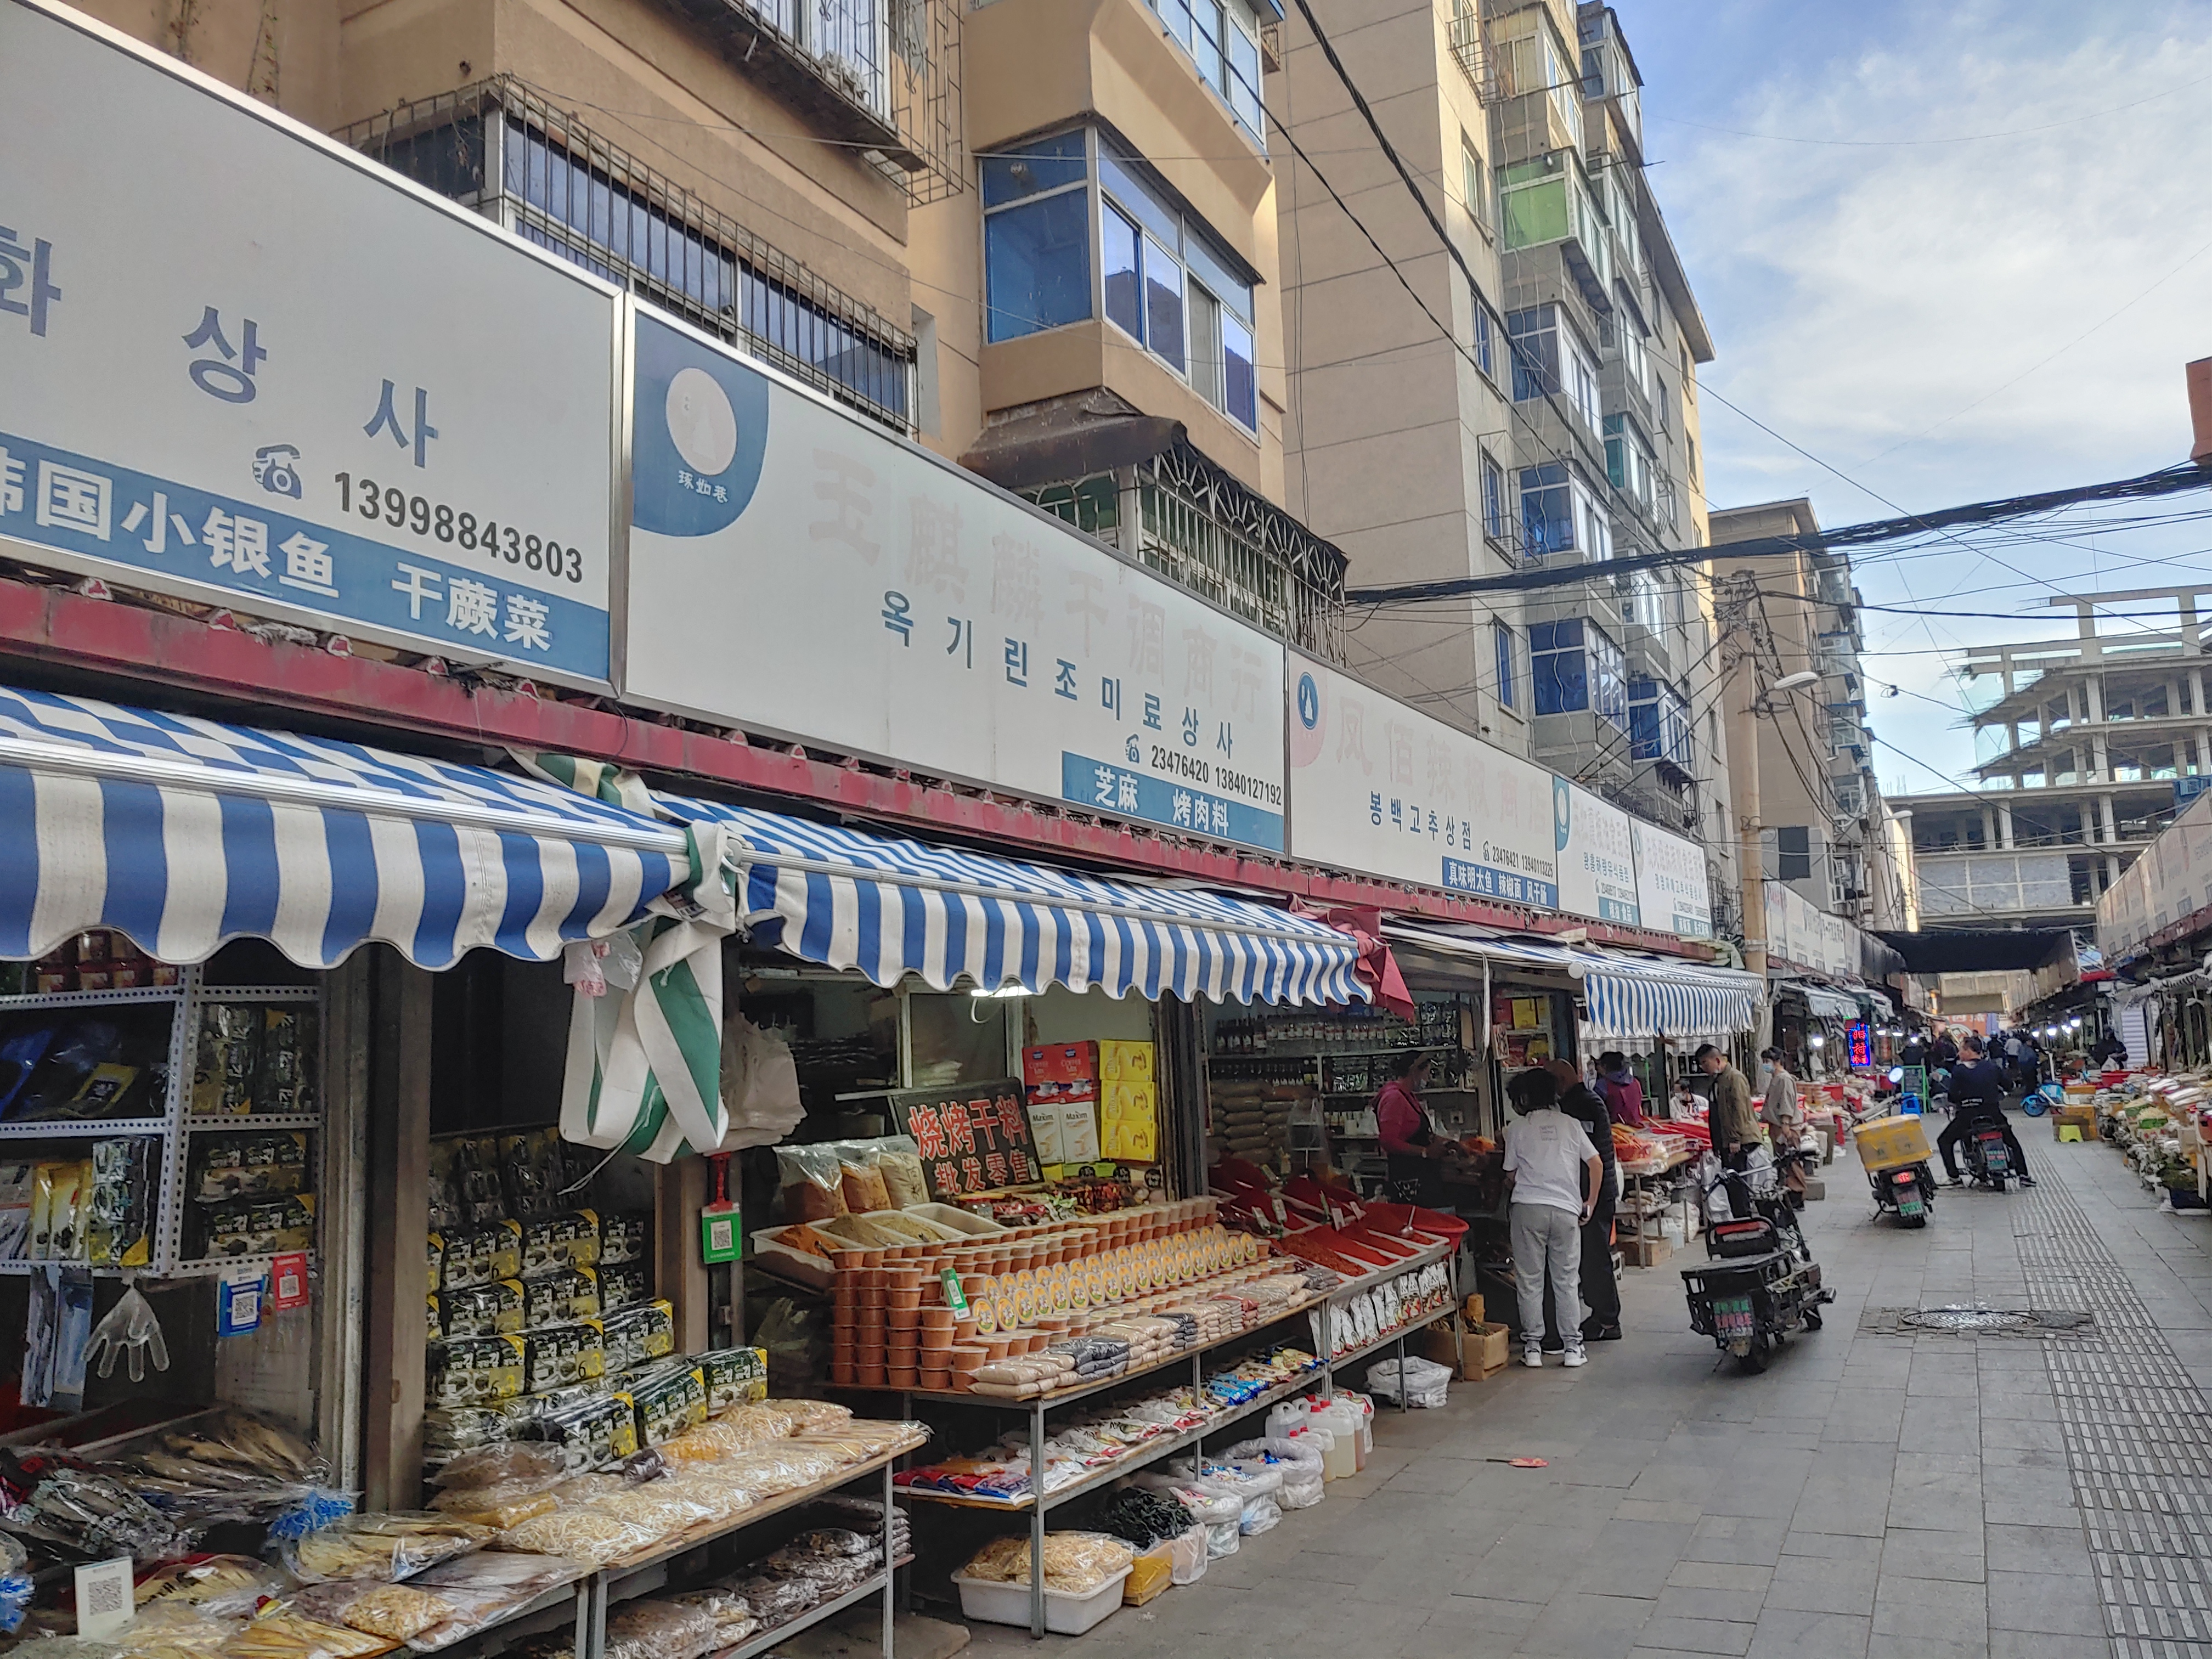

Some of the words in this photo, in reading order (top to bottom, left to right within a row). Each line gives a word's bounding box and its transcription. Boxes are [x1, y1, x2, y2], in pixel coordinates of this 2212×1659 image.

[334, 471, 583, 583] 13998843803
[391, 561, 552, 652] 干蕨菜
[1094, 765, 1138, 813] 芝麻
[1172, 788, 1229, 837] 烤肉料
[1151, 744, 1209, 784] 23476420
[1215, 766, 1282, 806] 13840127192
[1369, 790, 1471, 851] 봉백고추상점
[1448, 861, 1493, 894] 真味明太鱼
[1498, 872, 1522, 900] 辣椒面
[1526, 879, 1547, 905] 风干肠
[1492, 845, 1519, 869] 23476421
[1521, 854, 1554, 878] 13940113225
[907, 1094, 1028, 1161] 烧烤干料
[1032, 1112, 1054, 1122] Maxim
[1065, 1110, 1088, 1120] Maxim
[934, 1148, 1029, 1195] 批发零售
